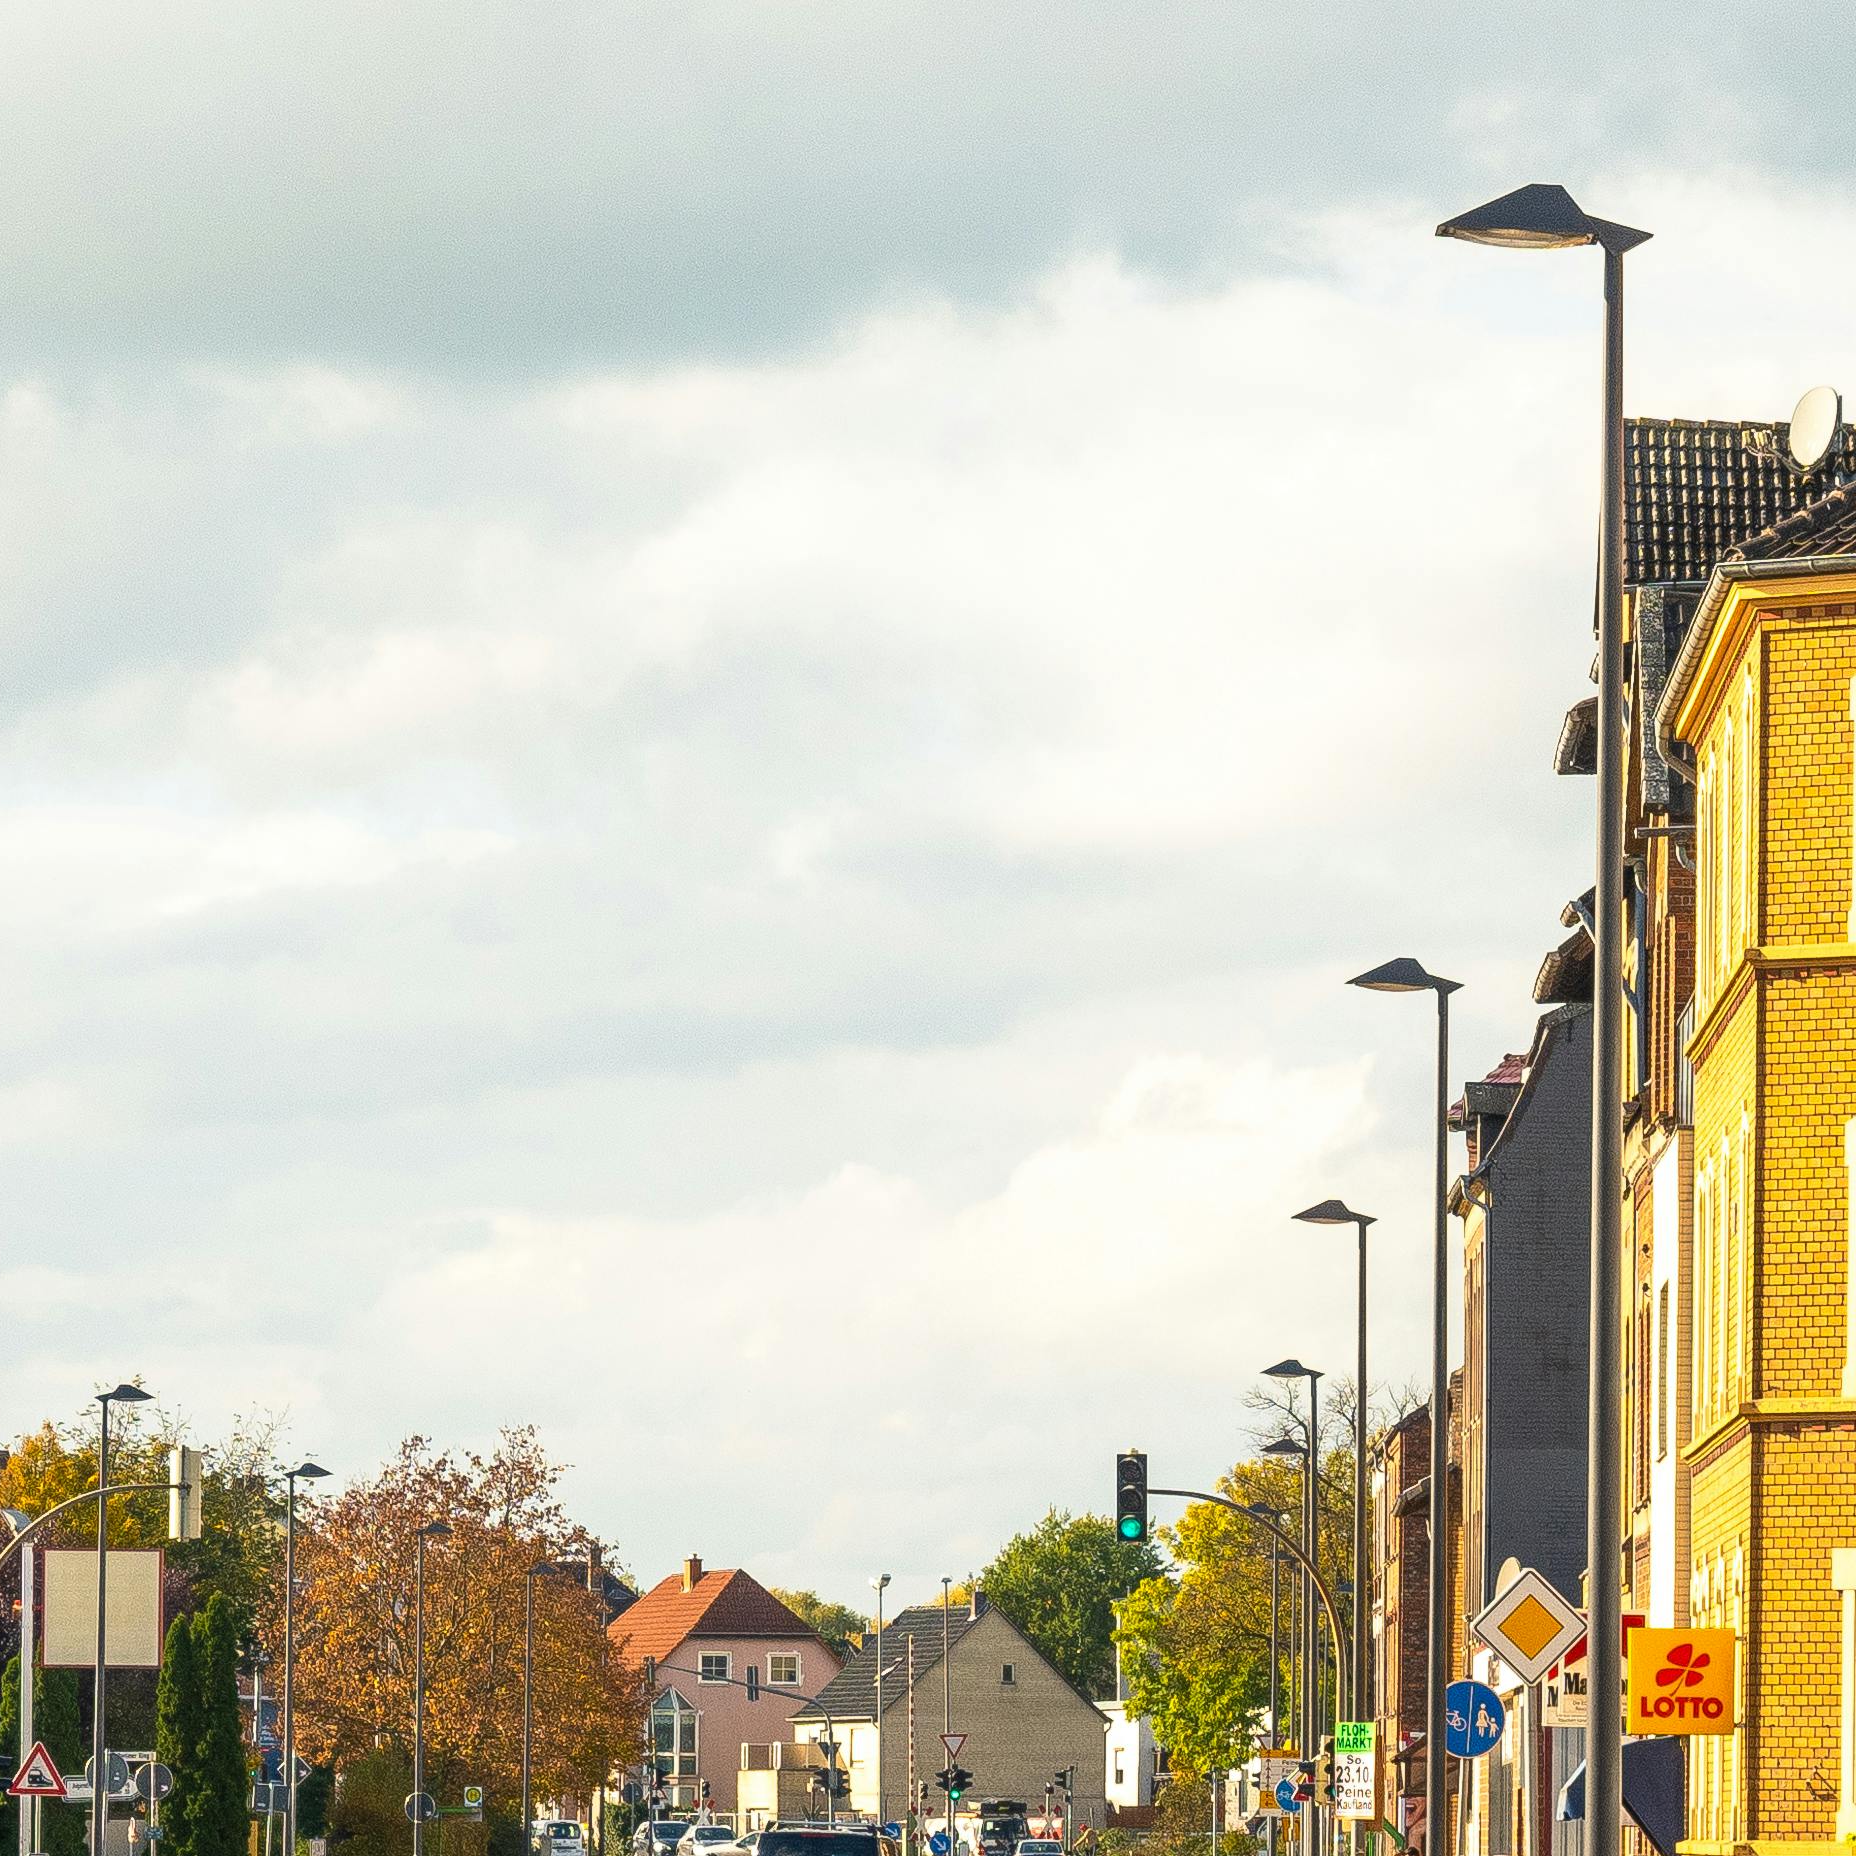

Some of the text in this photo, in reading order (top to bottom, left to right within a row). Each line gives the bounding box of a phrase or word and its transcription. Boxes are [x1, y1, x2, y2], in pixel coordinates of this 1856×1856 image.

[1640, 1695, 1704, 1720] LOTTO
[1341, 1725, 1369, 1737] FLOH-
[1337, 1737, 1373, 1749] MARKT
[1346, 1754, 1365, 1765] So.
[1336, 1766, 1373, 1784] 23.10.
[1336, 1785, 1372, 1798] Peine
[1337, 1798, 1372, 1810] Kaufland
